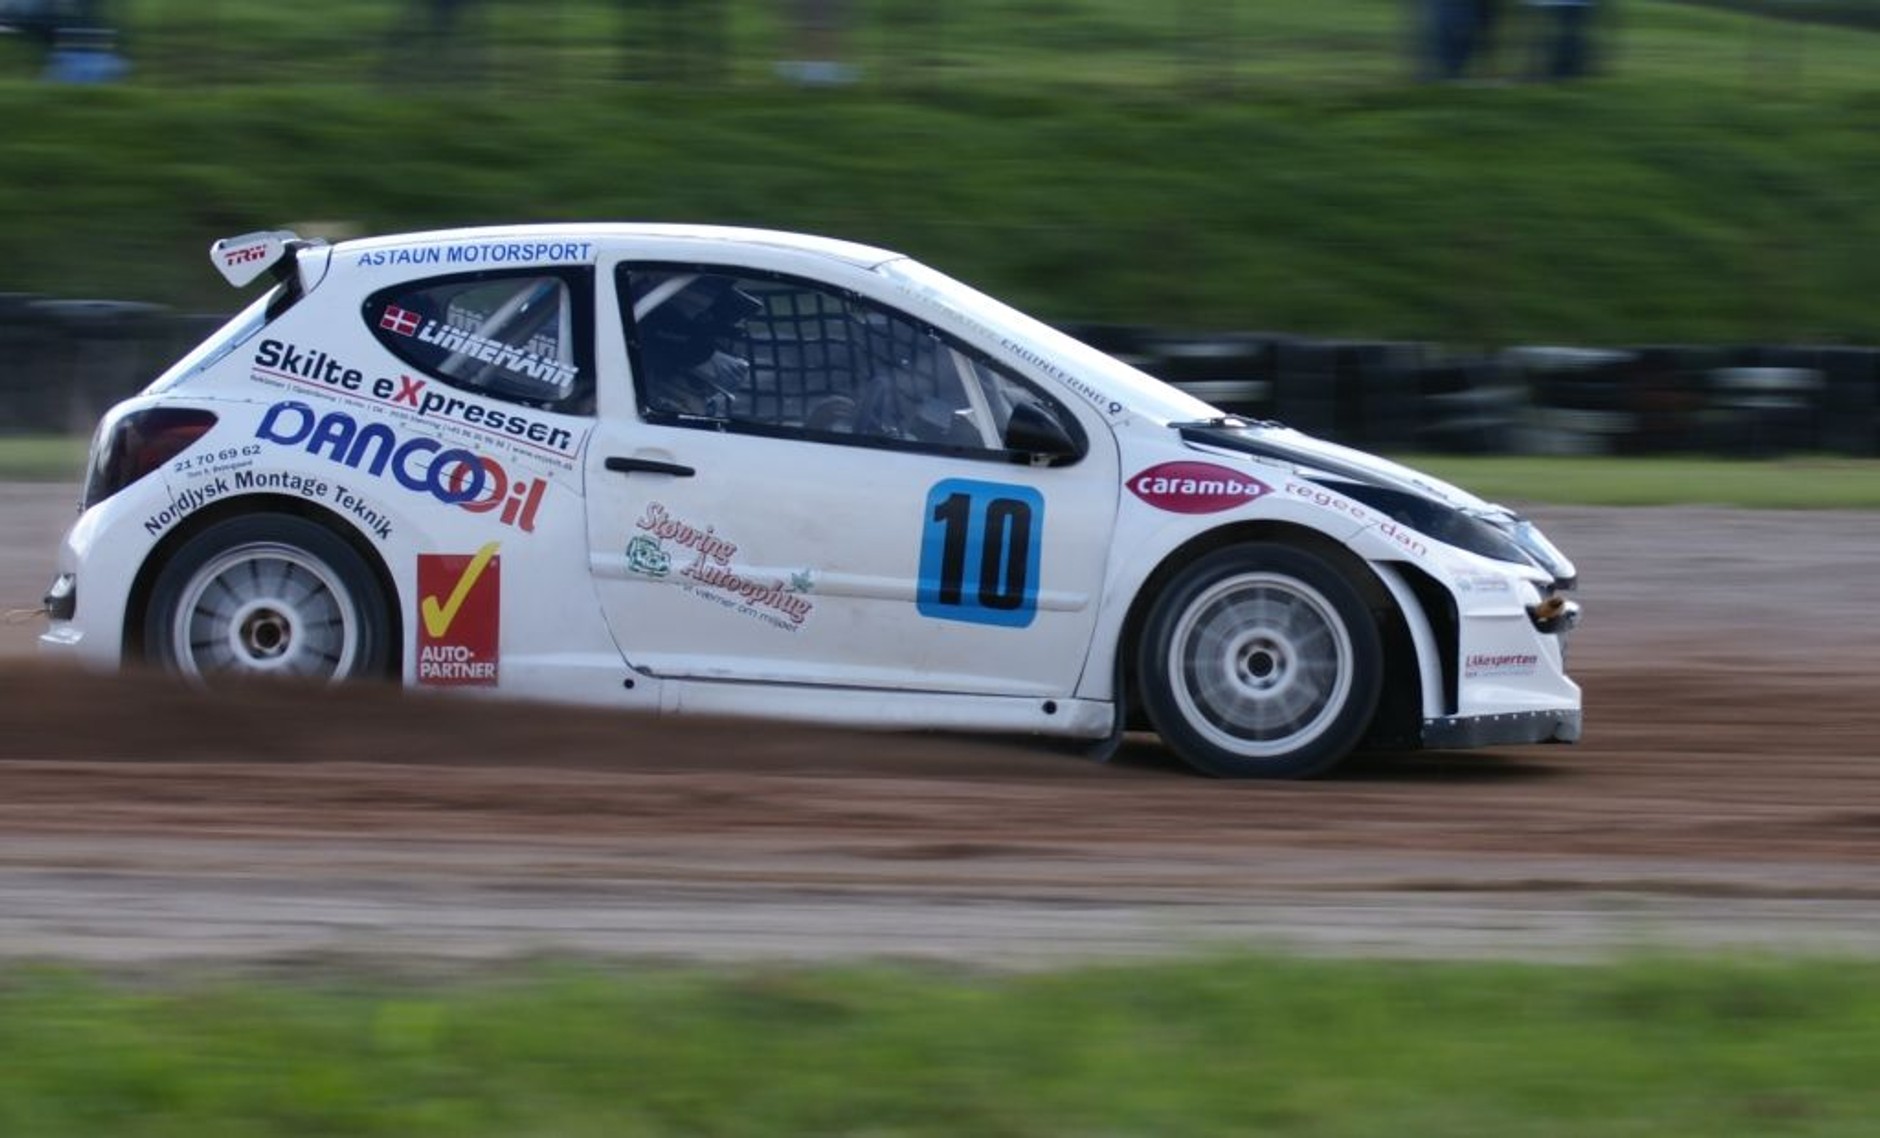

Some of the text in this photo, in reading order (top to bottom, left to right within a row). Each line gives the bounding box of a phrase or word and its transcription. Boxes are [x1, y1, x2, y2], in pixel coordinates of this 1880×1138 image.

[223, 243, 267, 267] TRW
[358, 243, 591, 266] ASTAUN MOTORSPORT
[255, 339, 573, 450] Skilte eXpressen
[174, 460, 191, 473] 21
[196, 453, 215, 466] 70
[218, 448, 238, 461] 69
[242, 444, 262, 457] 62
[1137, 474, 1261, 497] caramba
[144, 470, 393, 540] Nordjysk Montage Teknik
[636, 500, 738, 567] Støvring
[934, 493, 1032, 610] 10
[421, 646, 475, 663] AUTO-
[420, 662, 495, 679] PARTNER
